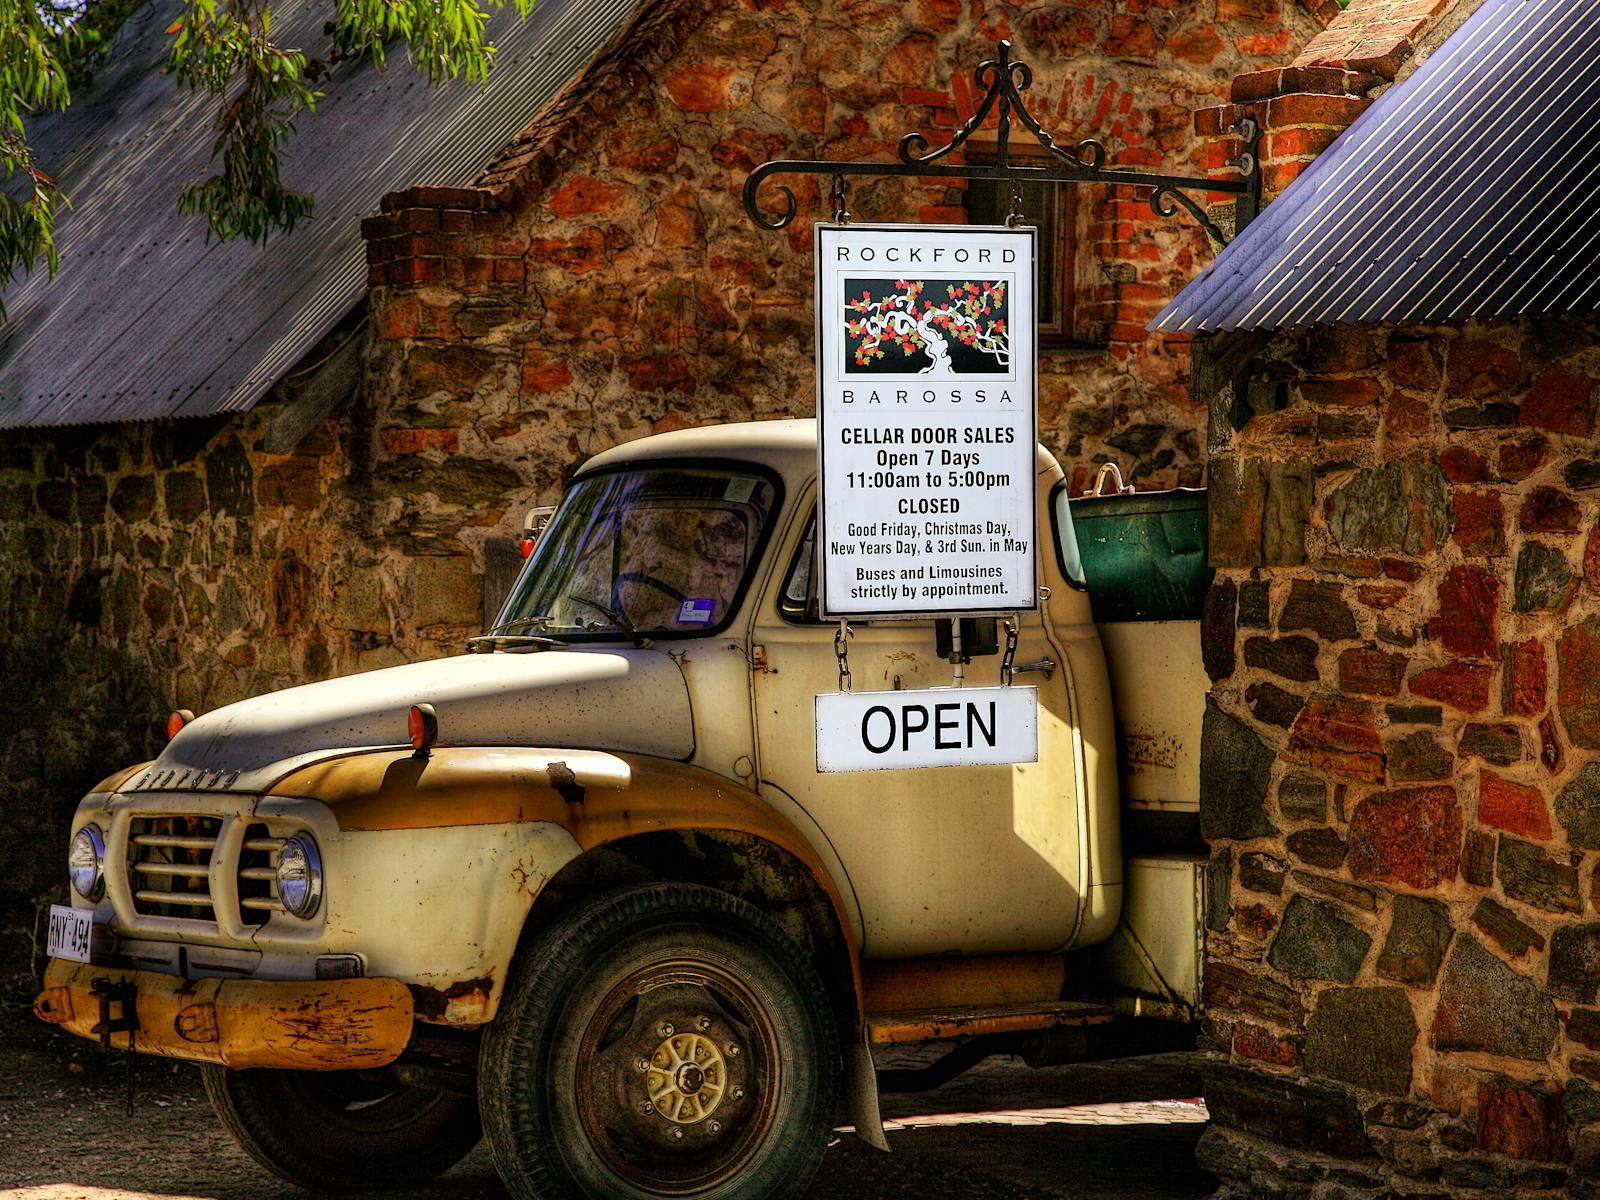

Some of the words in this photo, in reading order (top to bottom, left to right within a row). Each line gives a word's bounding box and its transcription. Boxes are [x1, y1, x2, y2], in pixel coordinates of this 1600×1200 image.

[837, 246, 1016, 263] ROCKFORD
[842, 389, 1012, 404] BAROSSA
[841, 427, 905, 445] CELLAR
[911, 427, 958, 444] DOOR
[963, 427, 1015, 444] SALES
[876, 449, 918, 470] Open
[924, 449, 935, 466] 7
[941, 449, 980, 469] Days
[846, 471, 920, 489] 11:00am
[925, 471, 942, 488] to
[948, 470, 1010, 491] 5:00pm
[898, 498, 960, 515] CLOSED
[848, 522, 877, 537] Good
[881, 522, 921, 540] Friday,
[925, 521, 983, 536] Christmas
[986, 520, 1011, 538] Day,
[831, 541, 856, 556] New
[859, 541, 892, 556] Years
[896, 540, 921, 557] Day,
[925, 539, 934, 554] &
[937, 538, 957, 554] 3rd
[960, 538, 986, 553] Sun.
[989, 538, 1000, 552] in
[1004, 538, 1028, 555] May
[856, 567, 896, 581] Buses
[900, 566, 924, 580] and
[929, 564, 1003, 580] Limousines
[851, 583, 898, 601] strictly
[902, 584, 917, 600] by
[921, 581, 1009, 600] appointment.
[861, 701, 996, 754] OPEN
